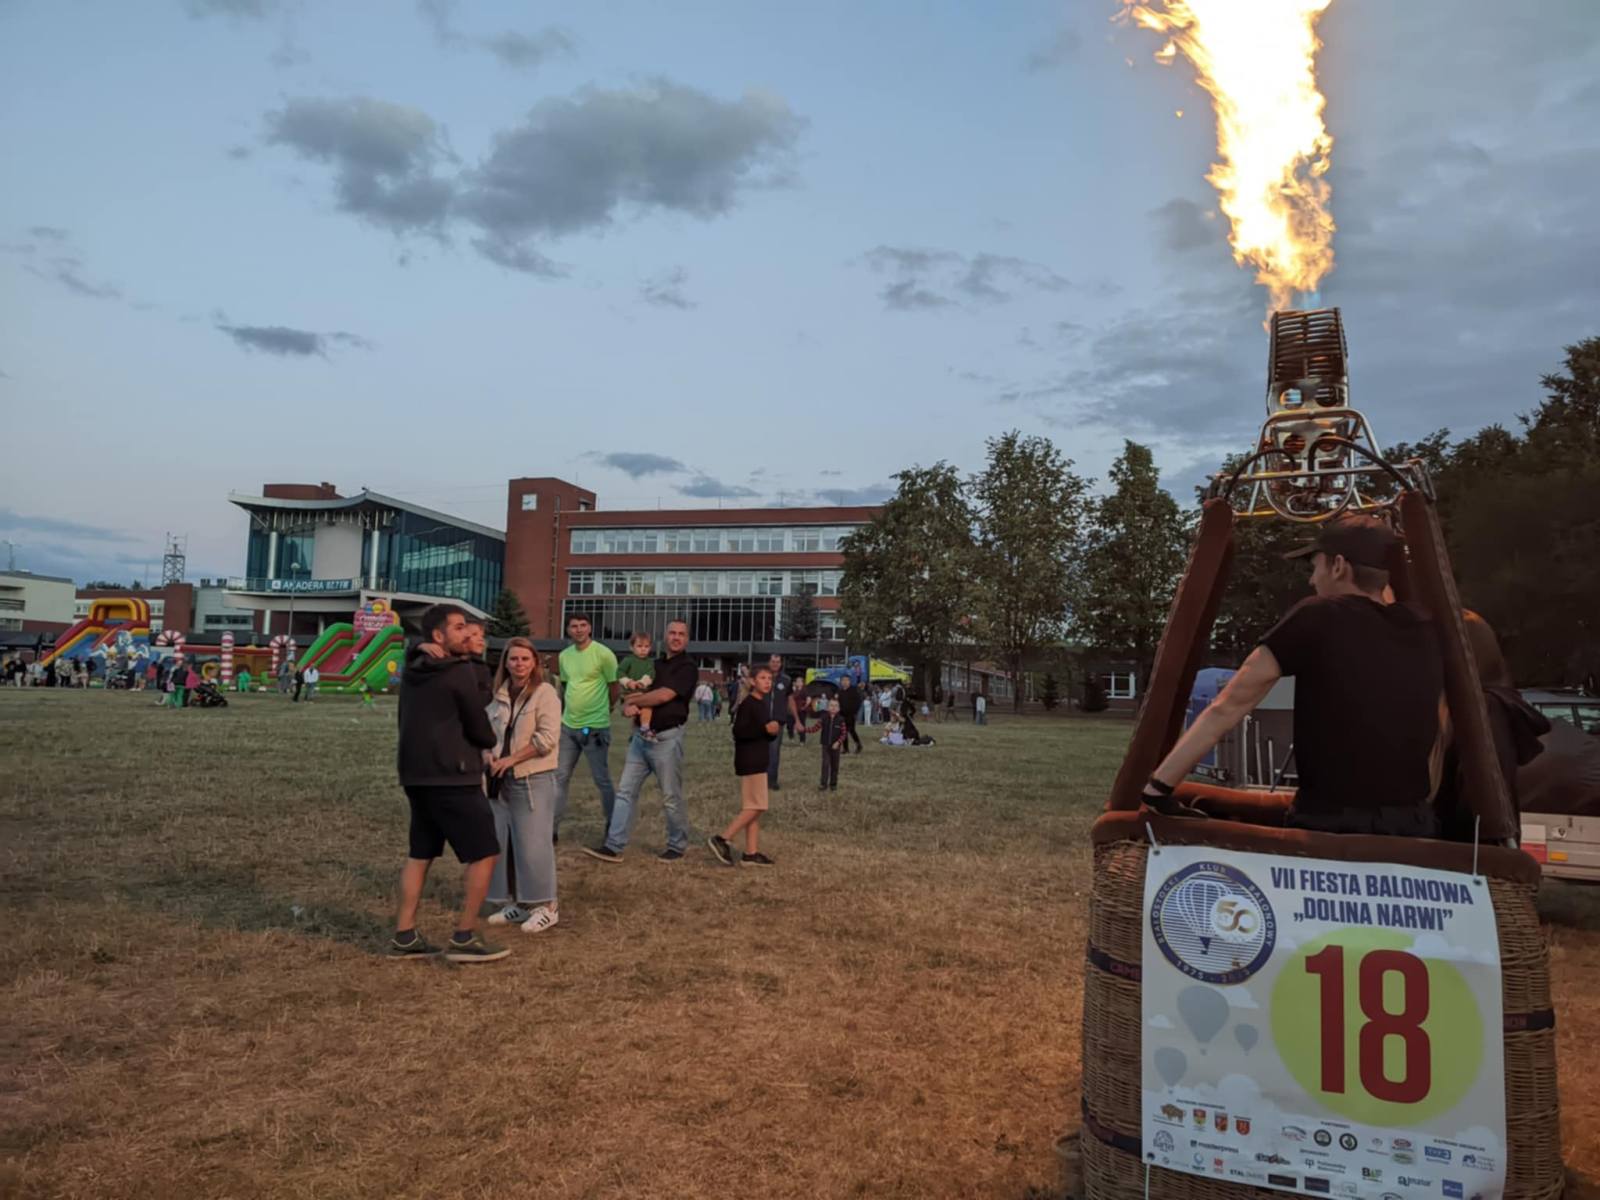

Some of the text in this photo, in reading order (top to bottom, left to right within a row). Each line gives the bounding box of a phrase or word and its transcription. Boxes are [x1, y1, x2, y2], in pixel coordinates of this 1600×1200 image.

[1199, 863, 1227, 874] KLUB
[1270, 866, 1474, 905] VII FIESTA BALONOWA
[1305, 944, 1431, 1104] 18
